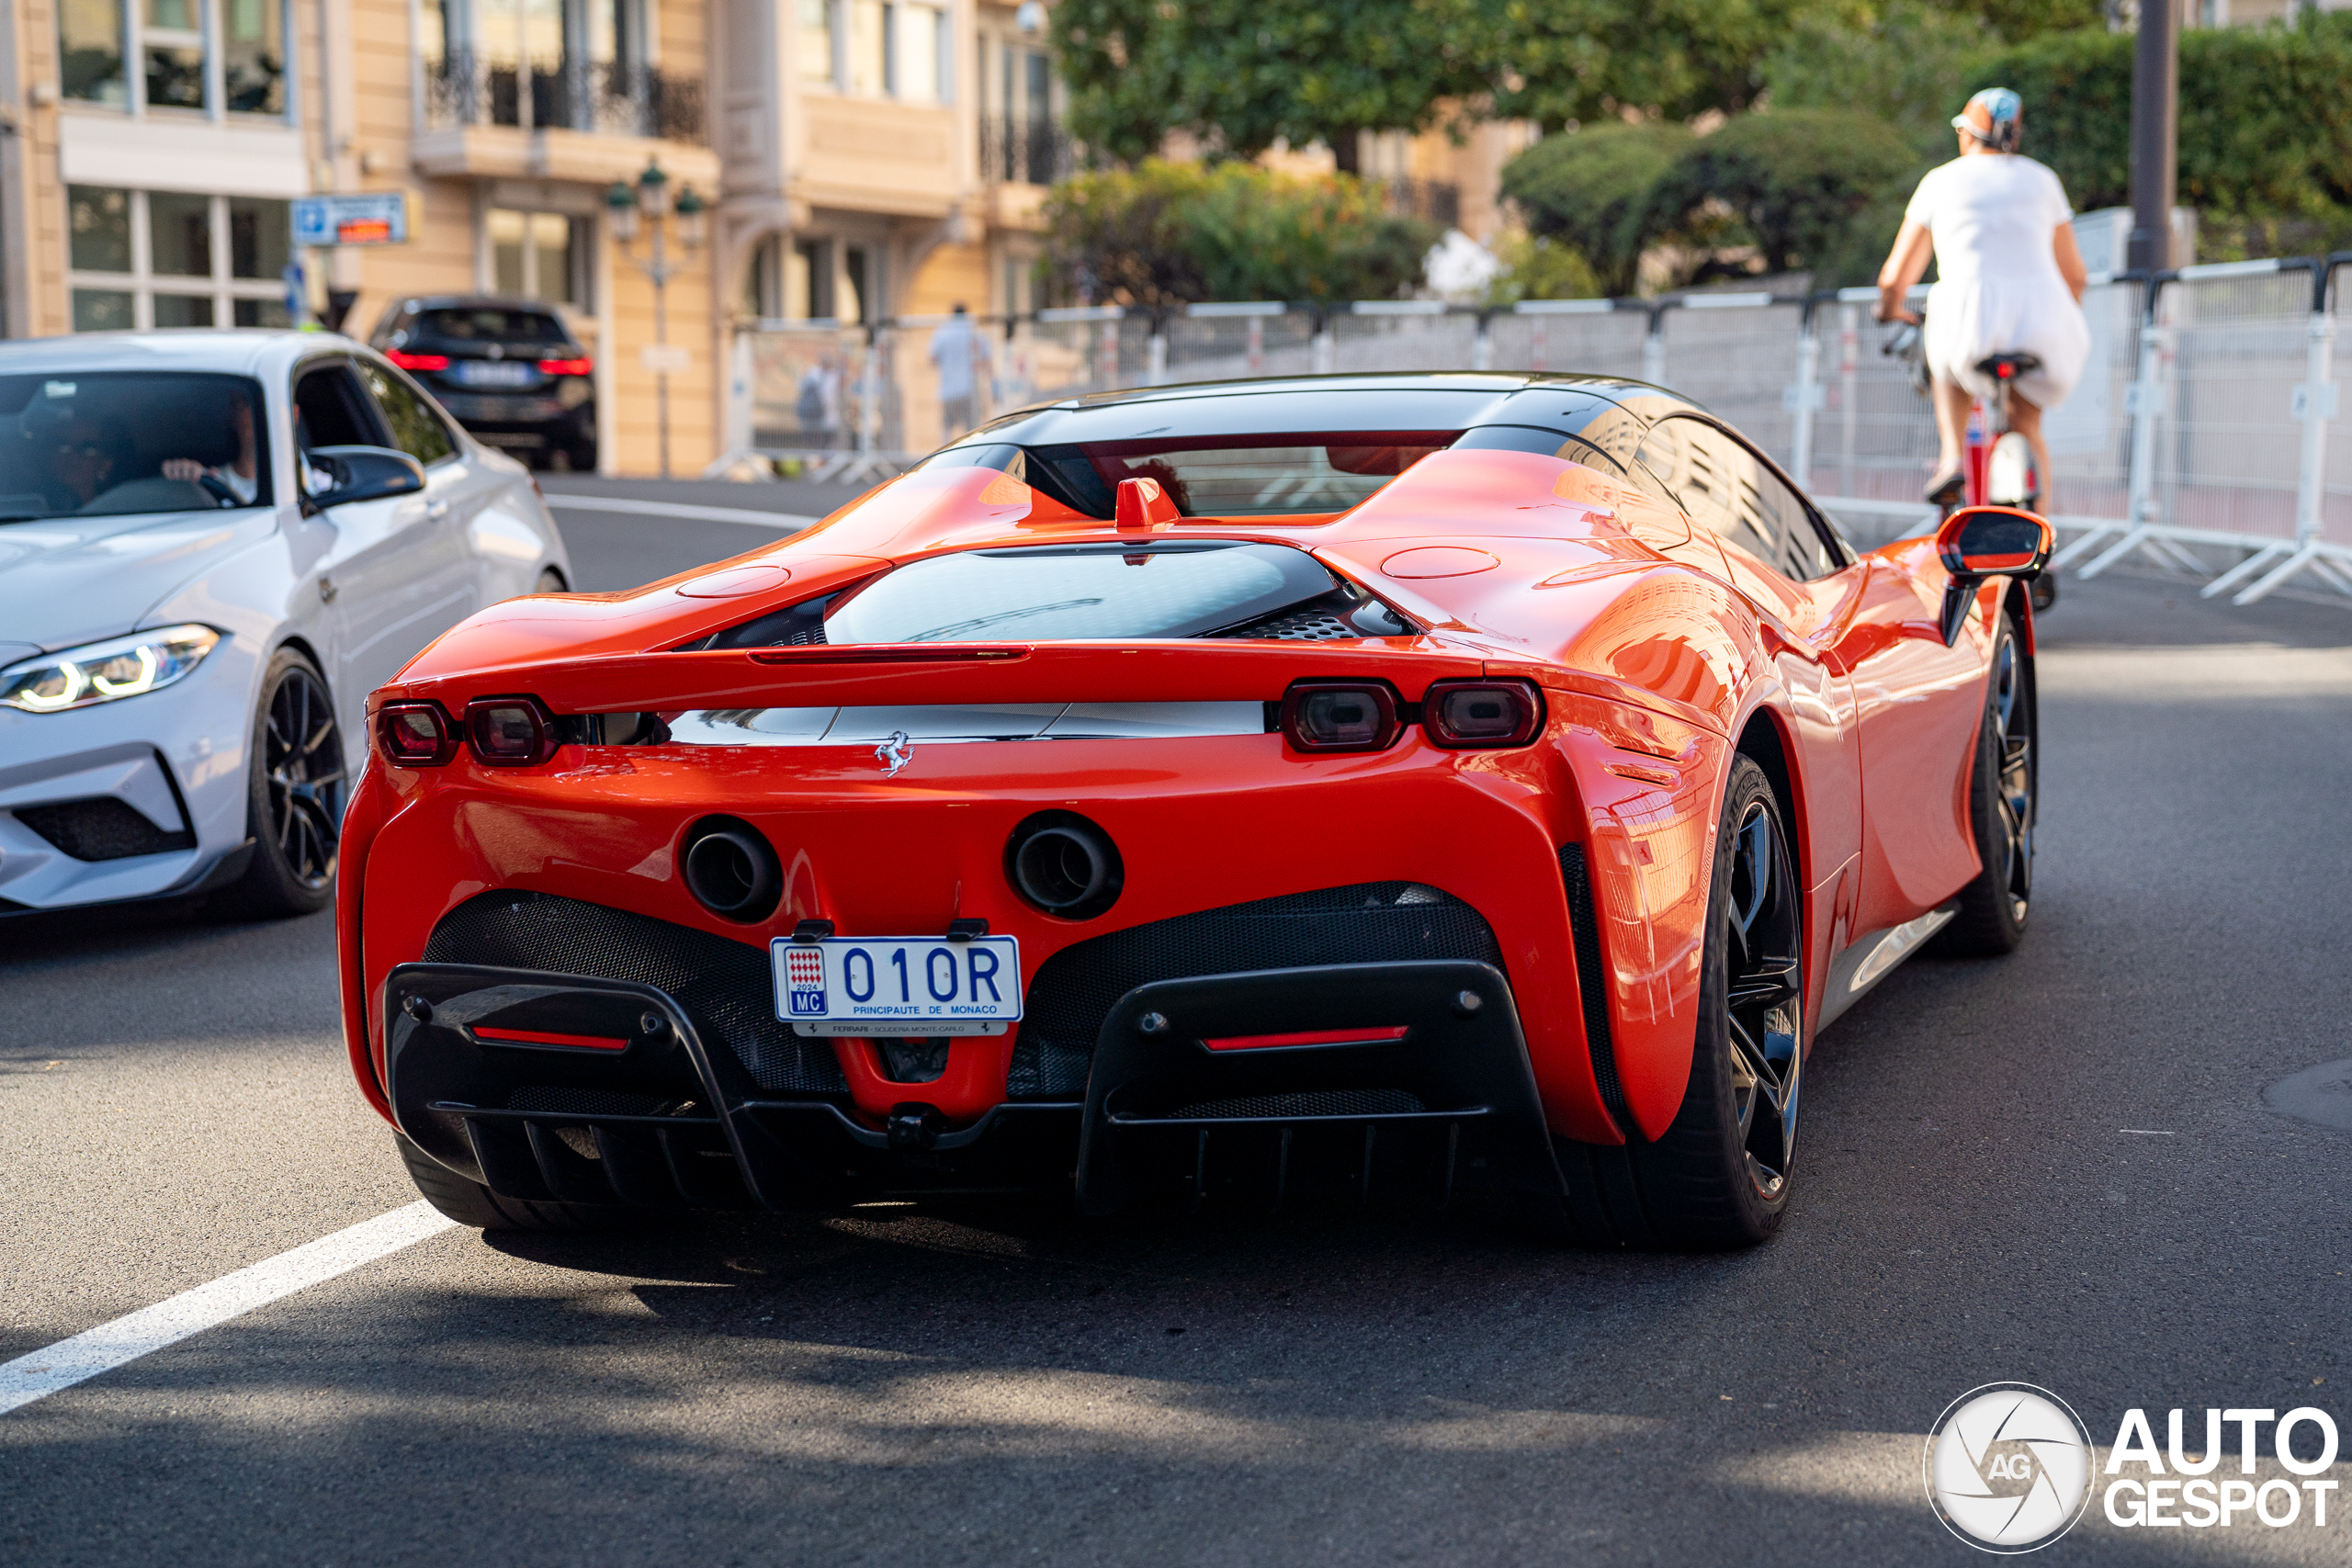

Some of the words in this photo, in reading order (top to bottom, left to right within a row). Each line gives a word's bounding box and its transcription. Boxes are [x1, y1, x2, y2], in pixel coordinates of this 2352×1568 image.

[843, 947, 1002, 1003] 010R
[797, 993, 820, 1011] MC
[854, 1006, 920, 1015] PRINCIPAUTE
[929, 1006, 942, 1014] DE
[951, 1005, 997, 1014] MONACO
